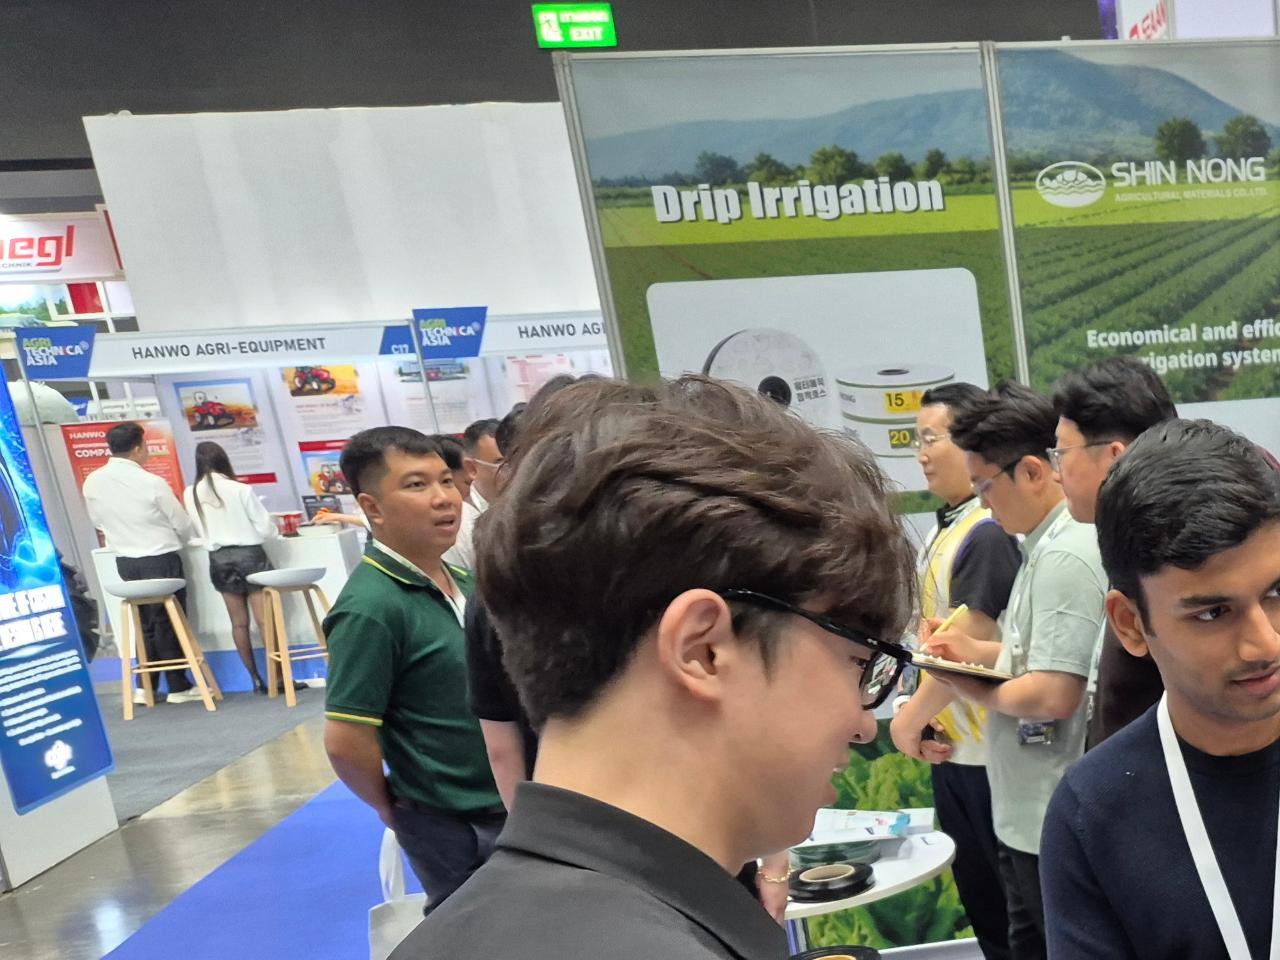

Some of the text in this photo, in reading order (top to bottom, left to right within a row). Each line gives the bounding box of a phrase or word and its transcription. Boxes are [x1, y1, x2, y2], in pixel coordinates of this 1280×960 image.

[1111, 157, 1266, 188] SHIN NONG
[650, 177, 945, 225] Drip Irrigation
[0, 224, 75, 267] egl
[518, 321, 606, 339] HANWO AG
[1087, 323, 1197, 349] Economical
[1202, 320, 1238, 342] and
[132, 337, 326, 361] HANWO AGRI-EQUIPMENT
[1141, 349, 1218, 375] rigation
[885, 393, 905, 407] 15
[890, 430, 910, 445] 20
[75, 449, 112, 459] COMPA
